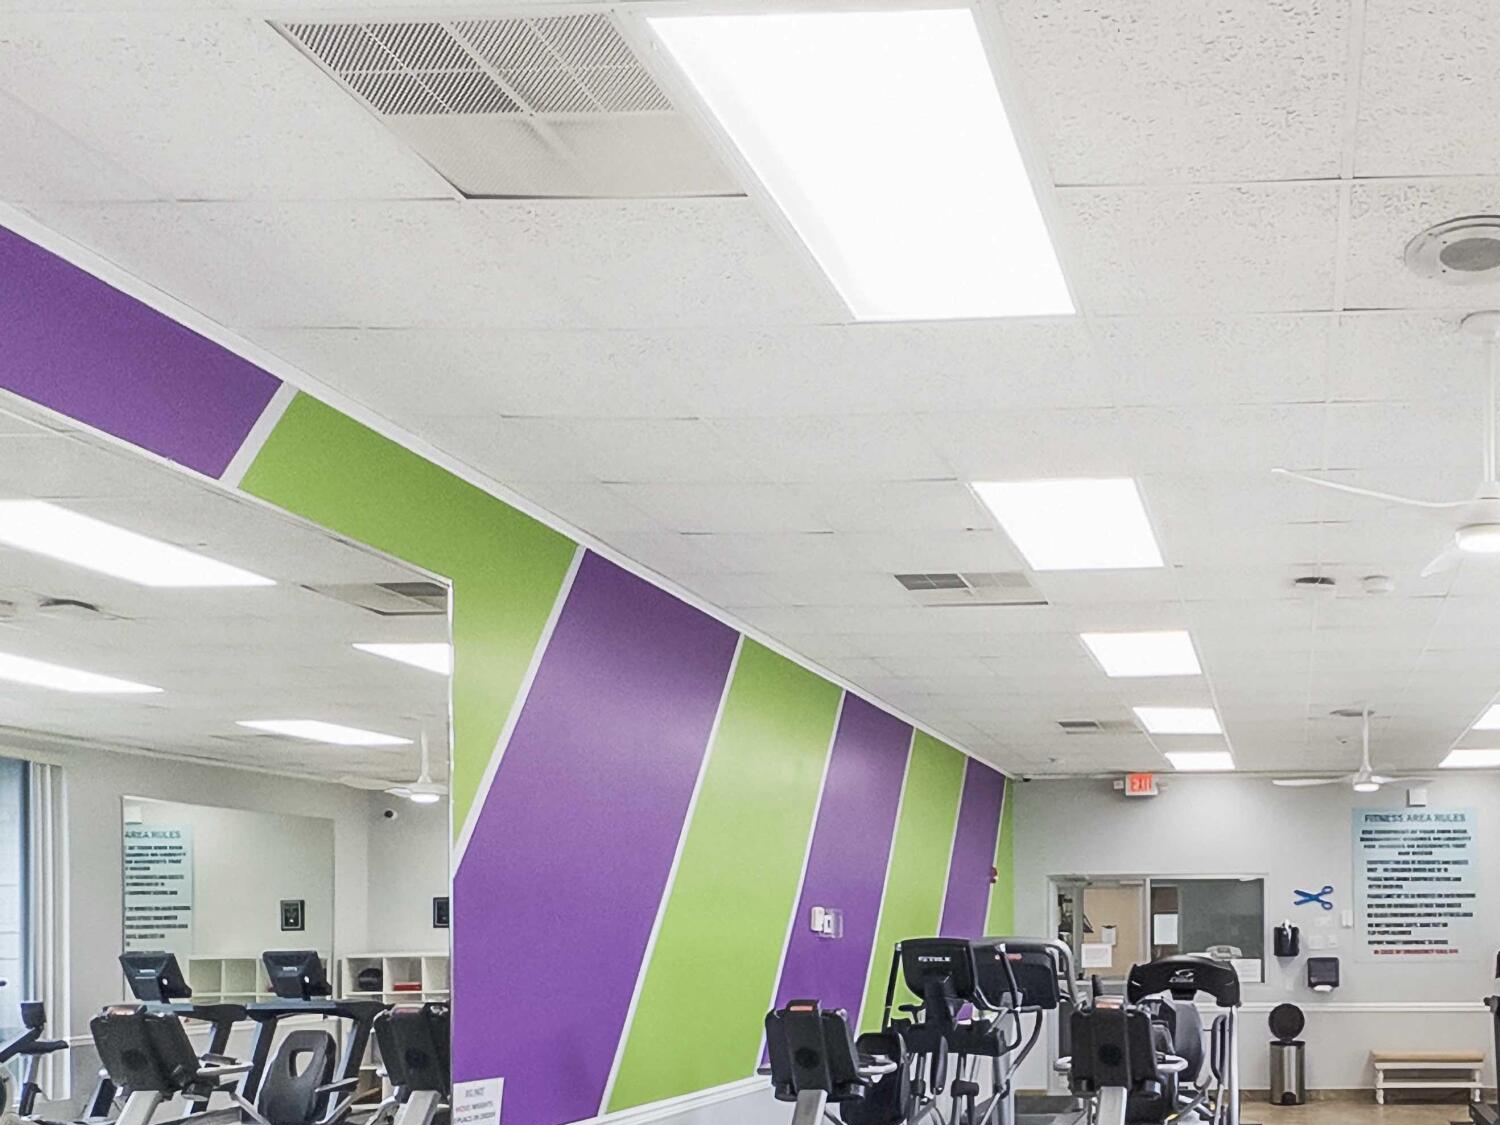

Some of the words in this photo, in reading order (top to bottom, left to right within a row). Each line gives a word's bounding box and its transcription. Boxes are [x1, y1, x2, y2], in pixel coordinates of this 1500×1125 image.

[1130, 776, 1153, 792] EXIT
[1364, 814, 1403, 823] FITNESS
[1406, 814, 1432, 822] AREA
[1434, 814, 1466, 822] RULES
